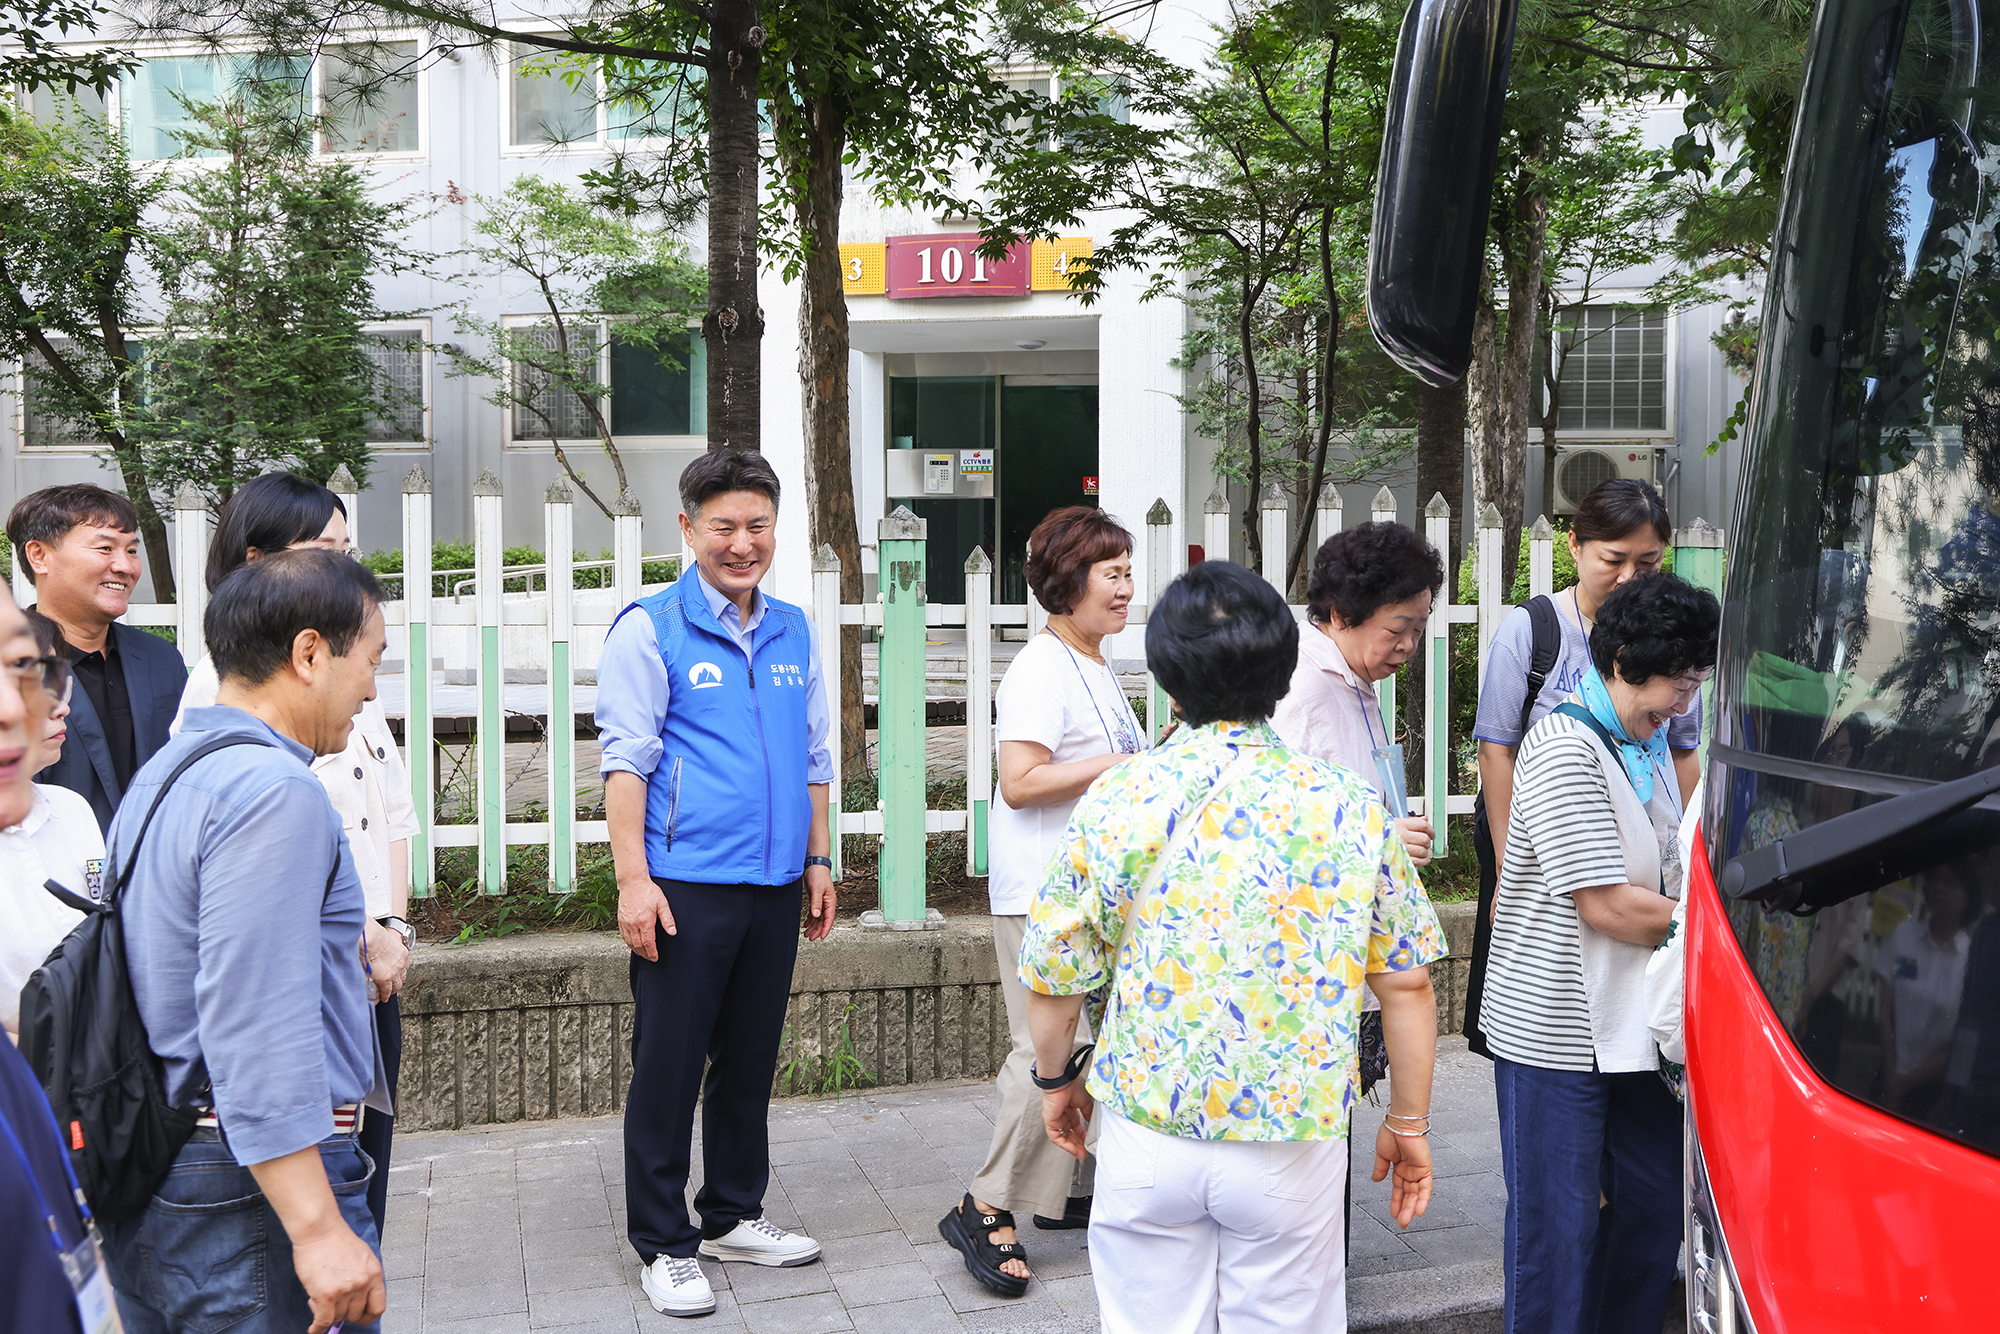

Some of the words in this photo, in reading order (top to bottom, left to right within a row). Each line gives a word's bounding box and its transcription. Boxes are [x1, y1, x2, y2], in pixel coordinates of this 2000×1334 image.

[846, 257, 863, 281] 3
[916, 246, 989, 284] 101
[1052, 251, 1069, 276] 4
